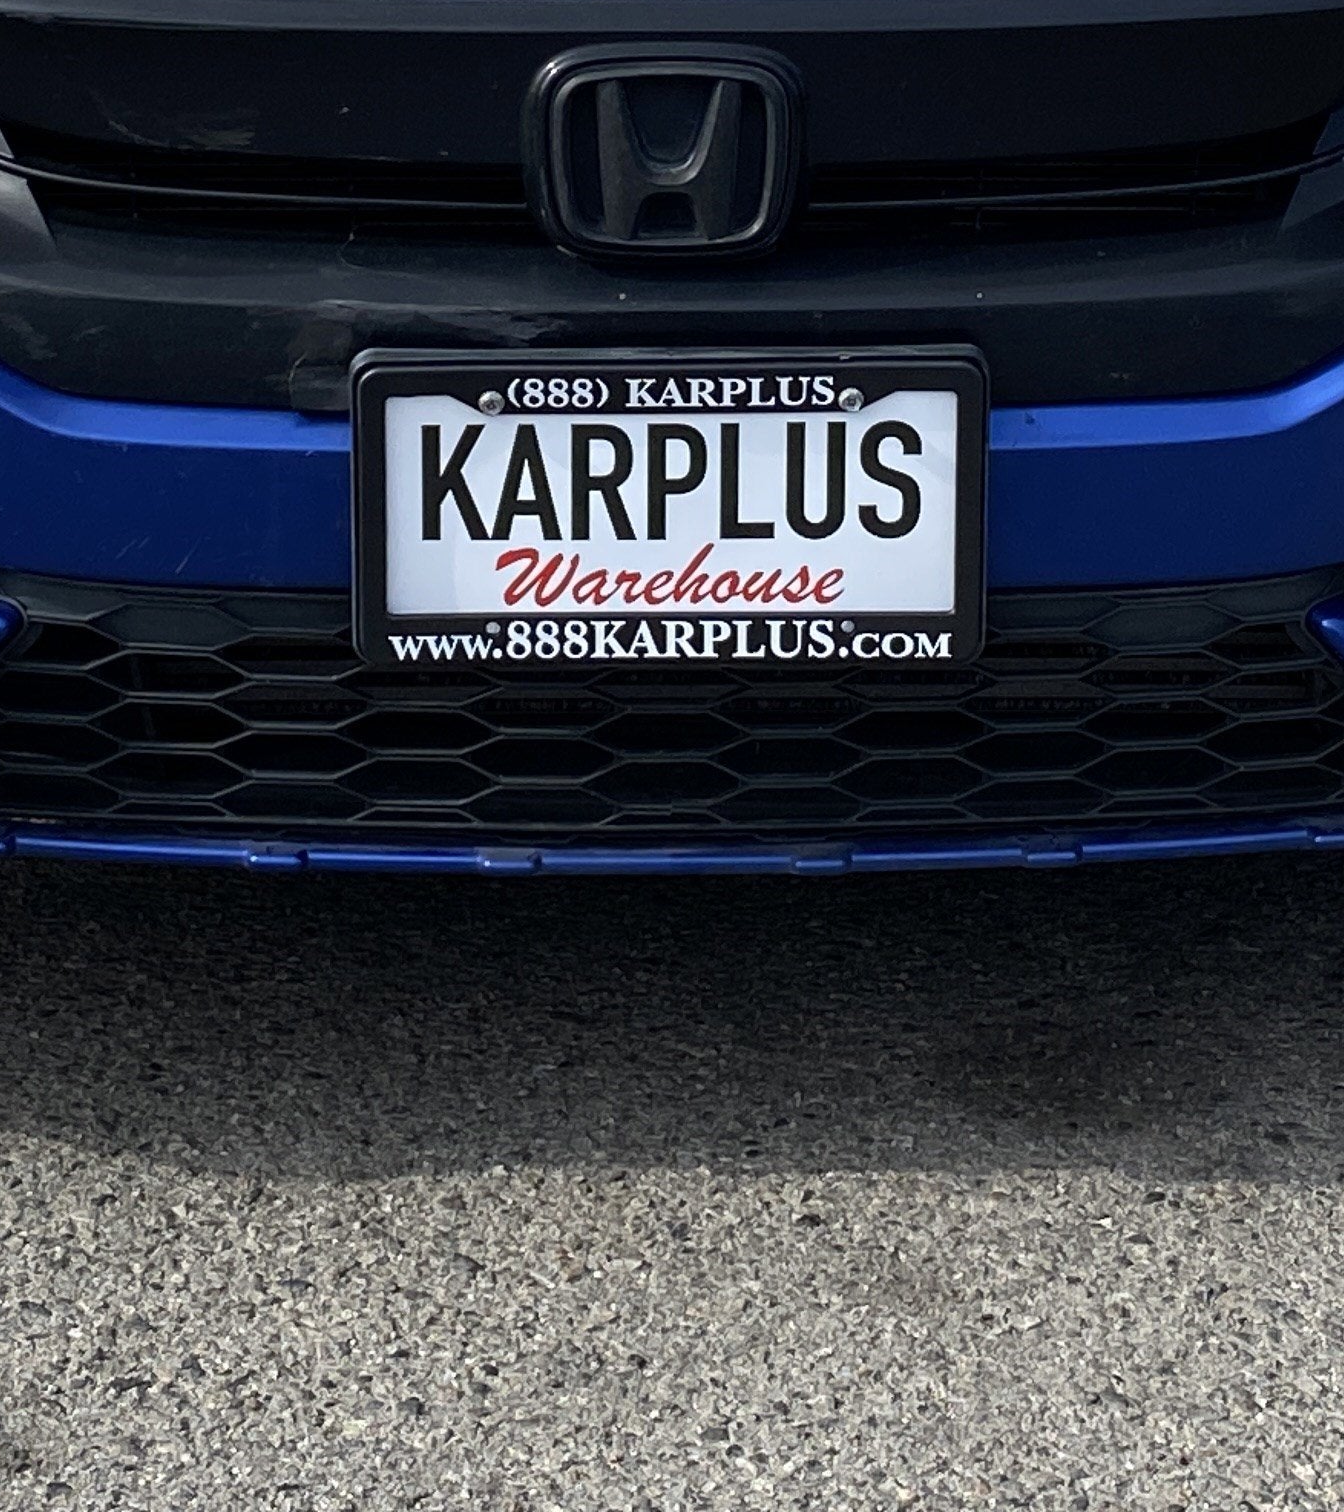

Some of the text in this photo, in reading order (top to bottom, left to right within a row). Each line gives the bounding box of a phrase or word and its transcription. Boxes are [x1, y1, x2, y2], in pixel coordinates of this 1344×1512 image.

[506, 375, 836, 409] (888) KARPLUS
[419, 418, 924, 542] KARPLUS
[494, 542, 845, 607] Warehouse
